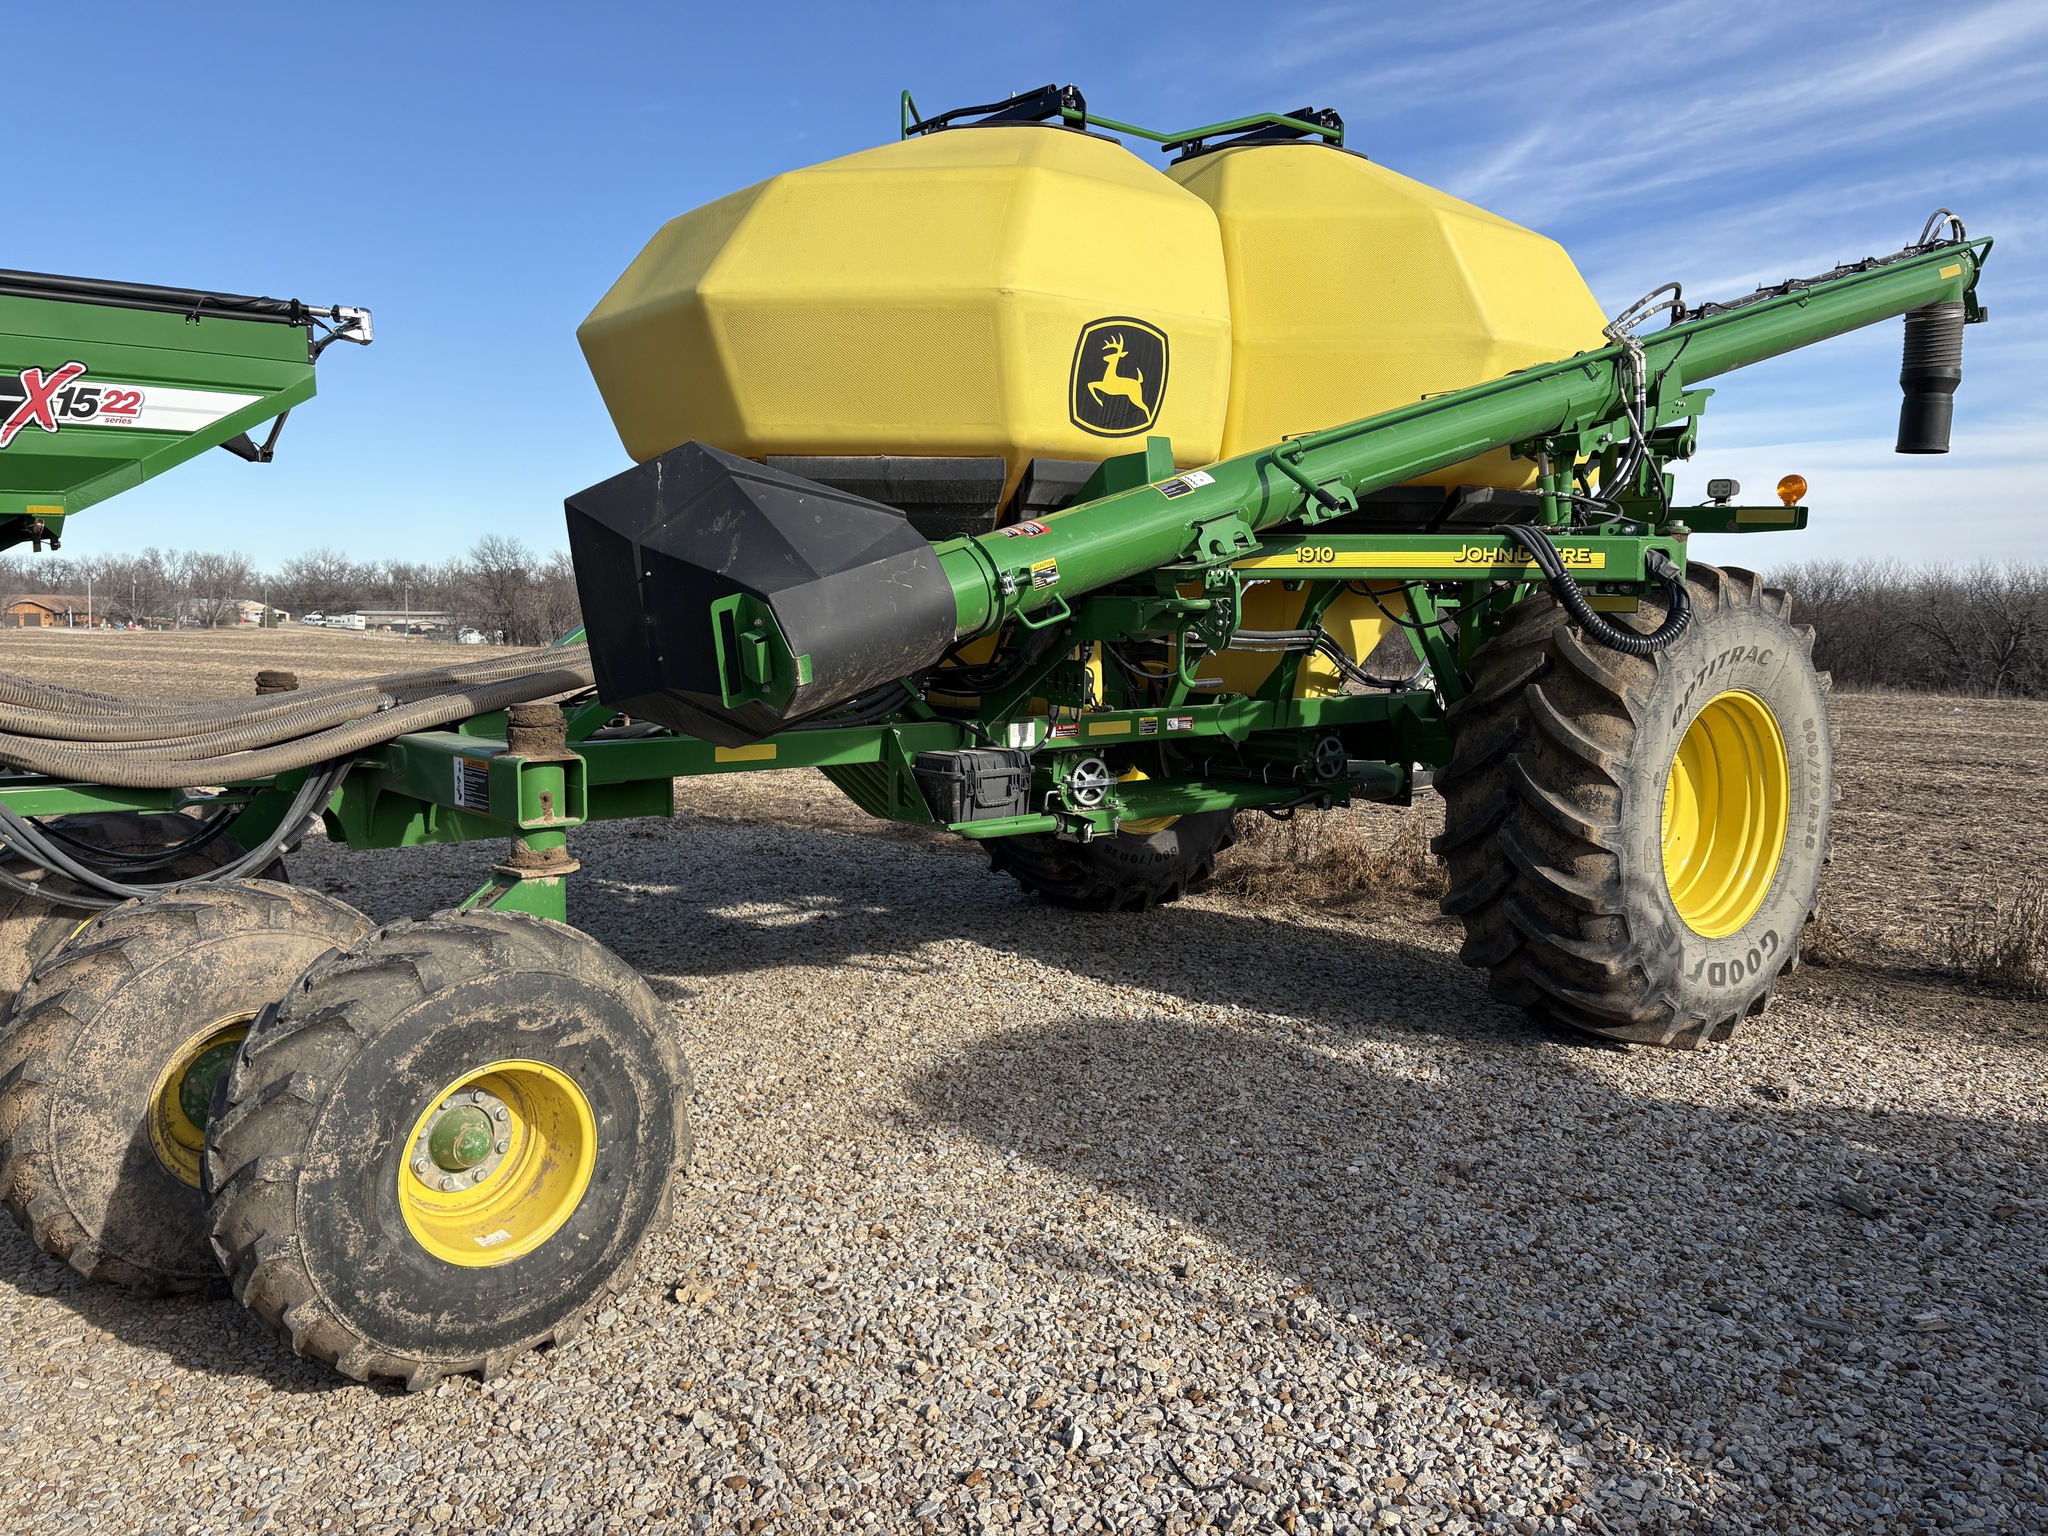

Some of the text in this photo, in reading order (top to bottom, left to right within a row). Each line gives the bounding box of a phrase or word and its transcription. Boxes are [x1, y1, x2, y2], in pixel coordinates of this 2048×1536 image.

[104, 416, 133, 425] series
[1296, 546, 1334, 562] 1910
[1454, 544, 1591, 563] JOHN DRE
[1672, 645, 1774, 729] OPTITRAC
[1802, 717, 1822, 850] 800/70R38
[1103, 843, 1178, 867] 800/70R38
